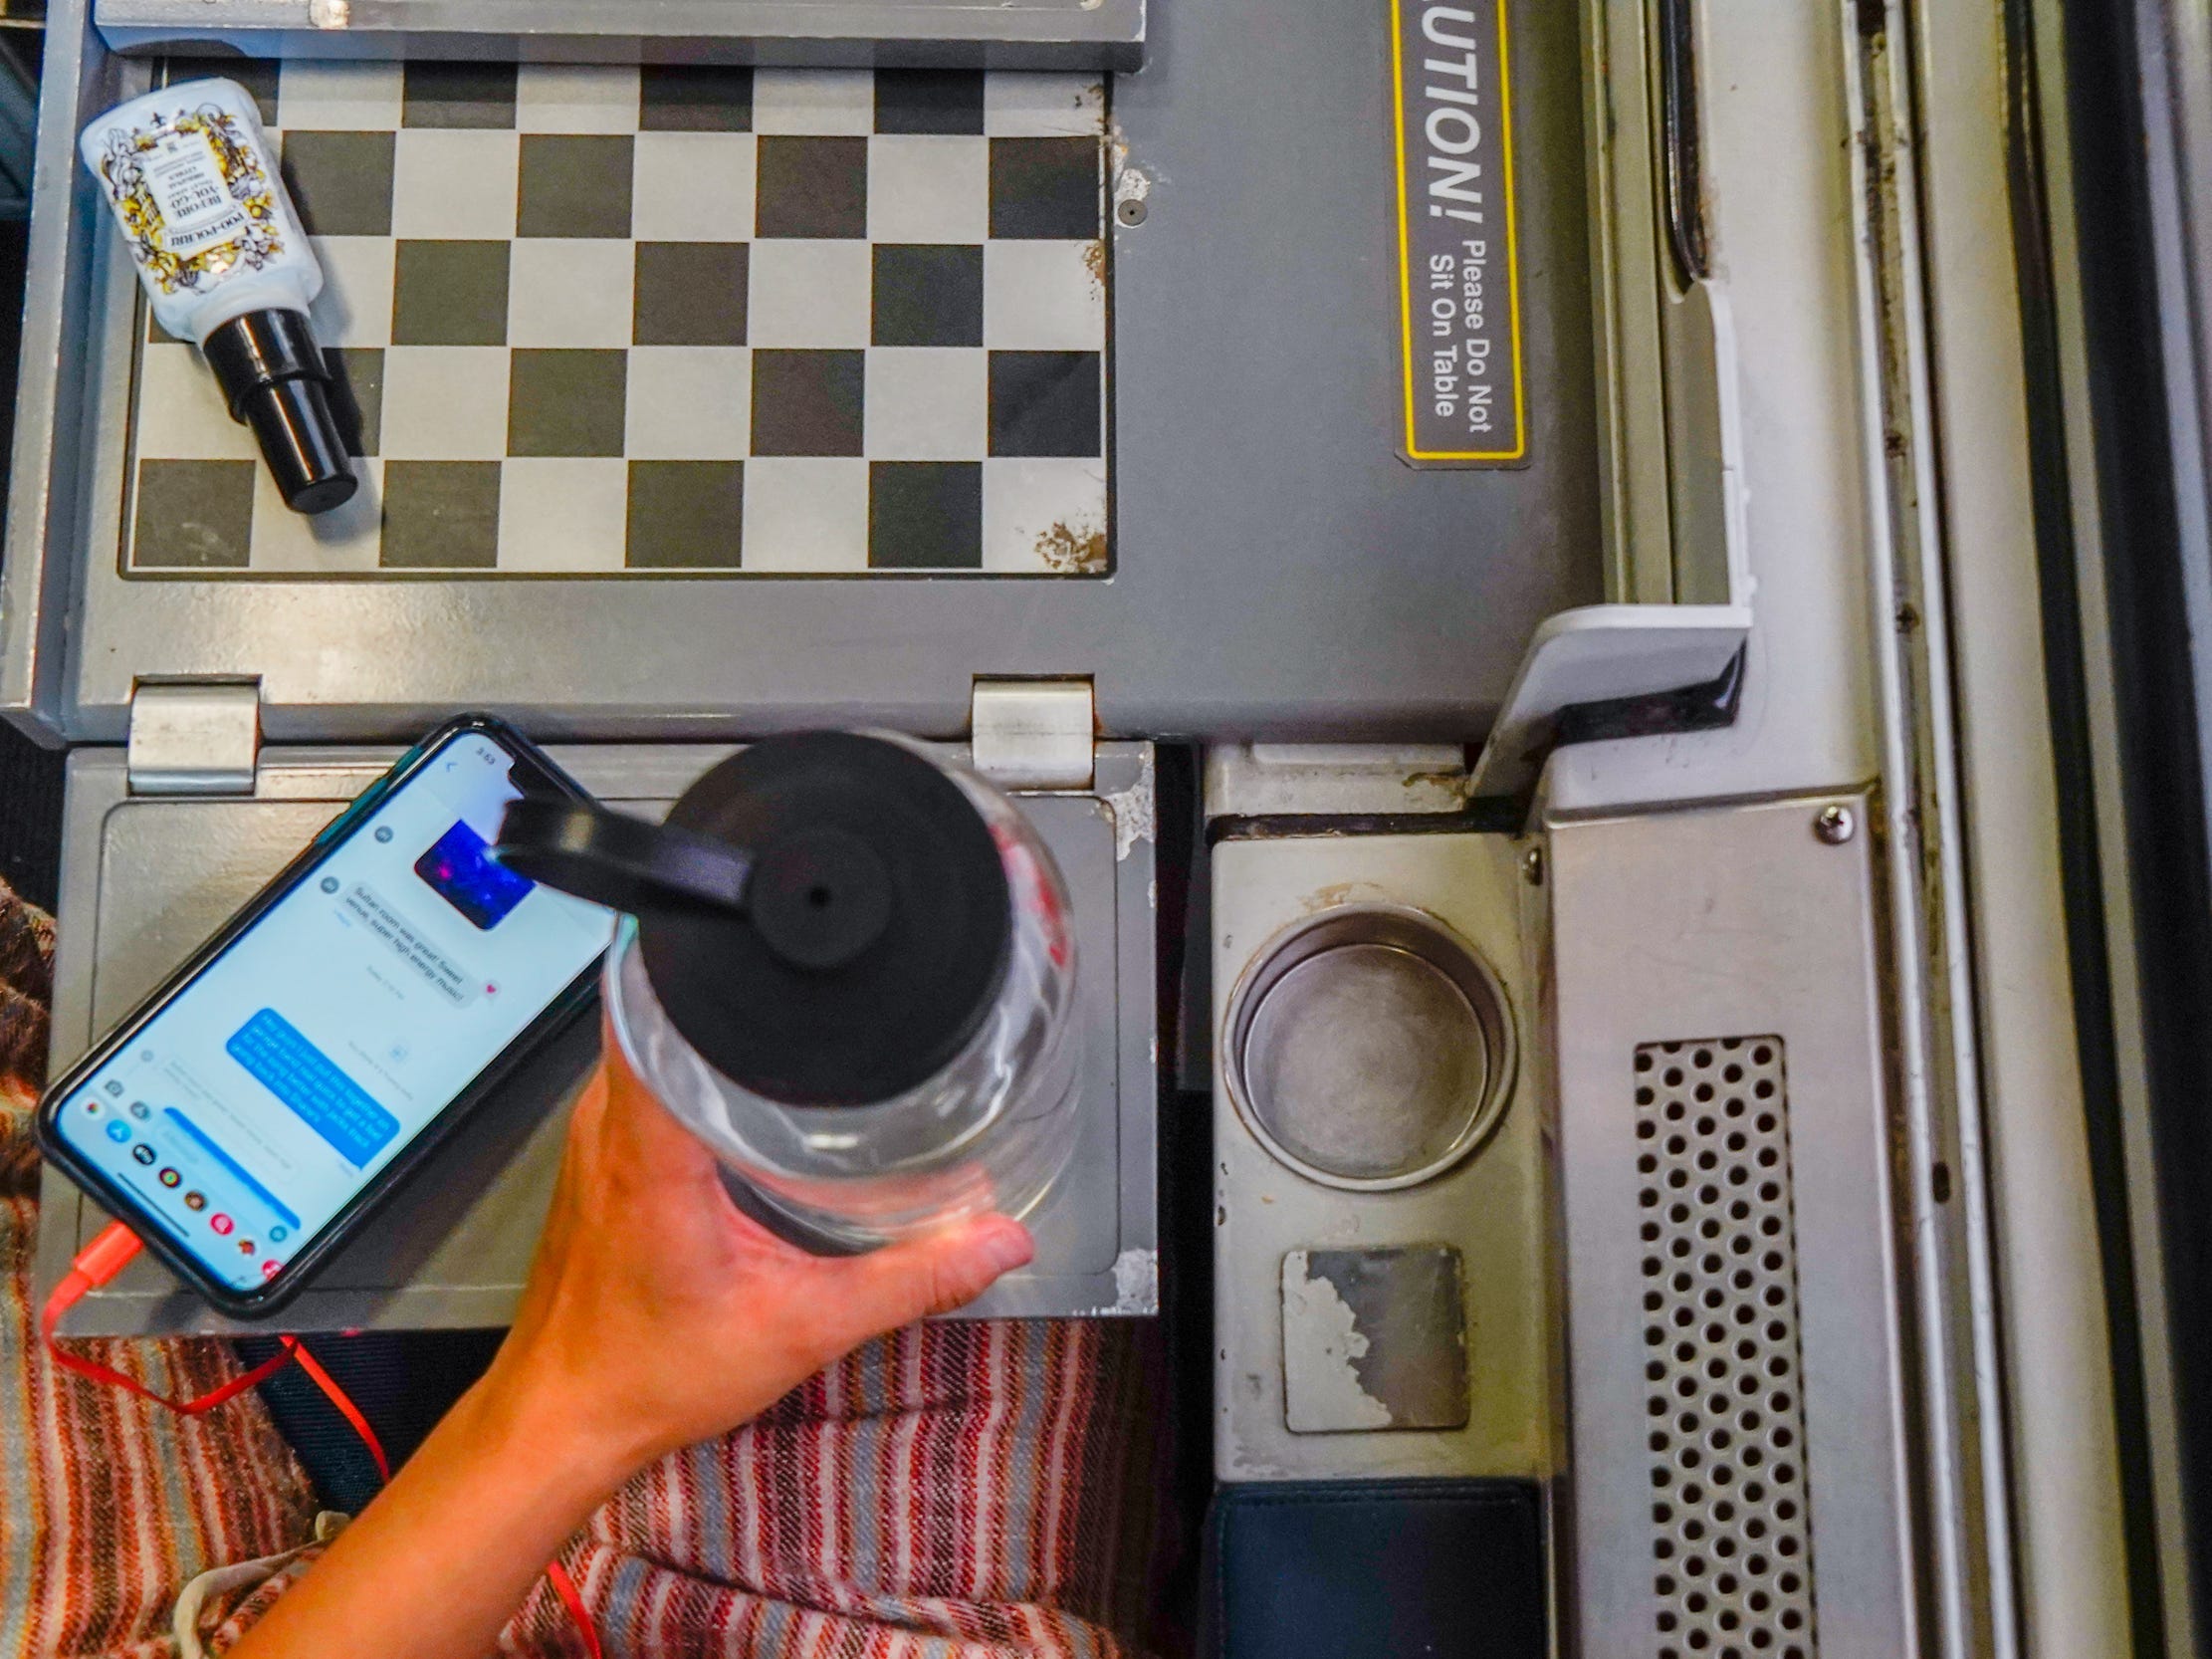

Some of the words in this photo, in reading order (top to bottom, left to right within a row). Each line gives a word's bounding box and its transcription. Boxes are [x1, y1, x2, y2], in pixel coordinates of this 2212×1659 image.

[1421, 0, 1483, 224] UTION!
[176, 195, 223, 218] BEFORE
[170, 212, 245, 247] POO-POURRI
[1431, 254, 1455, 291] Sit
[1461, 240, 1486, 330] Please
[1432, 299, 1456, 337] On
[1465, 339, 1490, 376] Do
[1434, 347, 1458, 418] Table
[1468, 385, 1492, 434] Not
